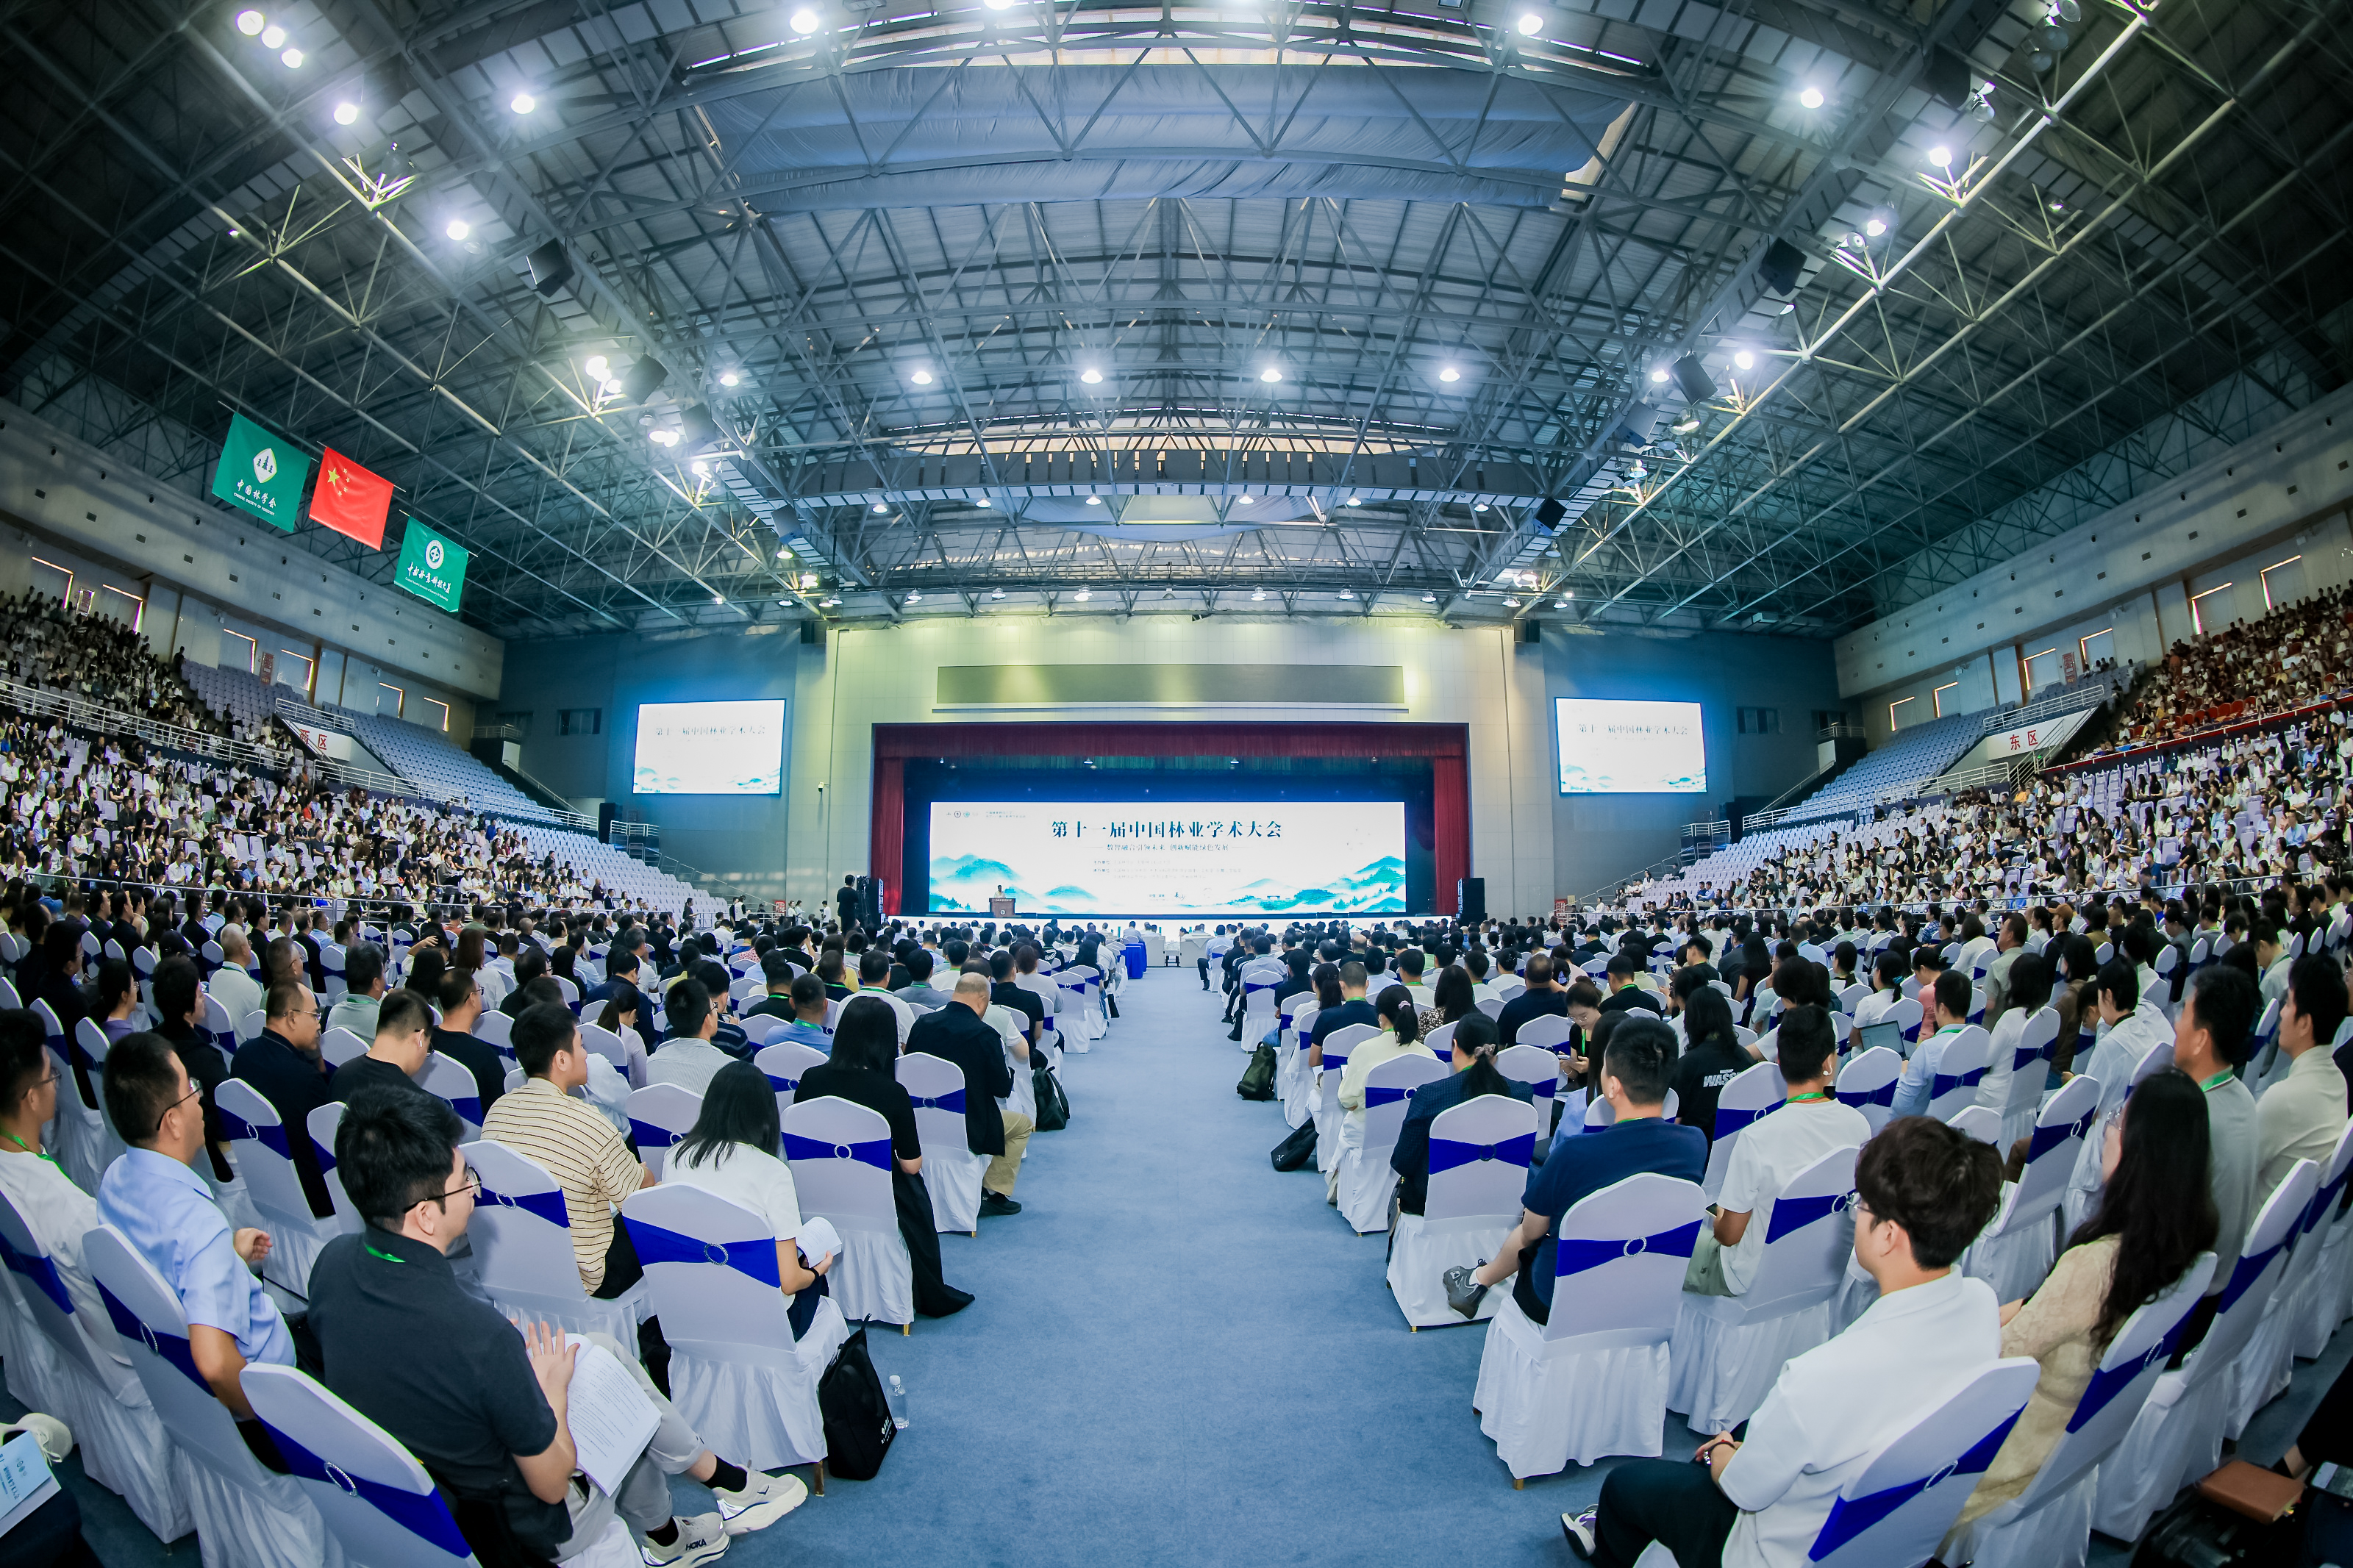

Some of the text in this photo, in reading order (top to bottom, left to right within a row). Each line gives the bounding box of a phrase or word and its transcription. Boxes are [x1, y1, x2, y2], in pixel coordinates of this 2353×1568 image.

[237, 479, 276, 509] 中国林学会
[299, 728, 328, 751] 西区
[2010, 729, 2038, 751] 东区
[1051, 820, 1282, 838] 第十一届中国林业学术大会
[685, 1538, 707, 1551] HOKA
